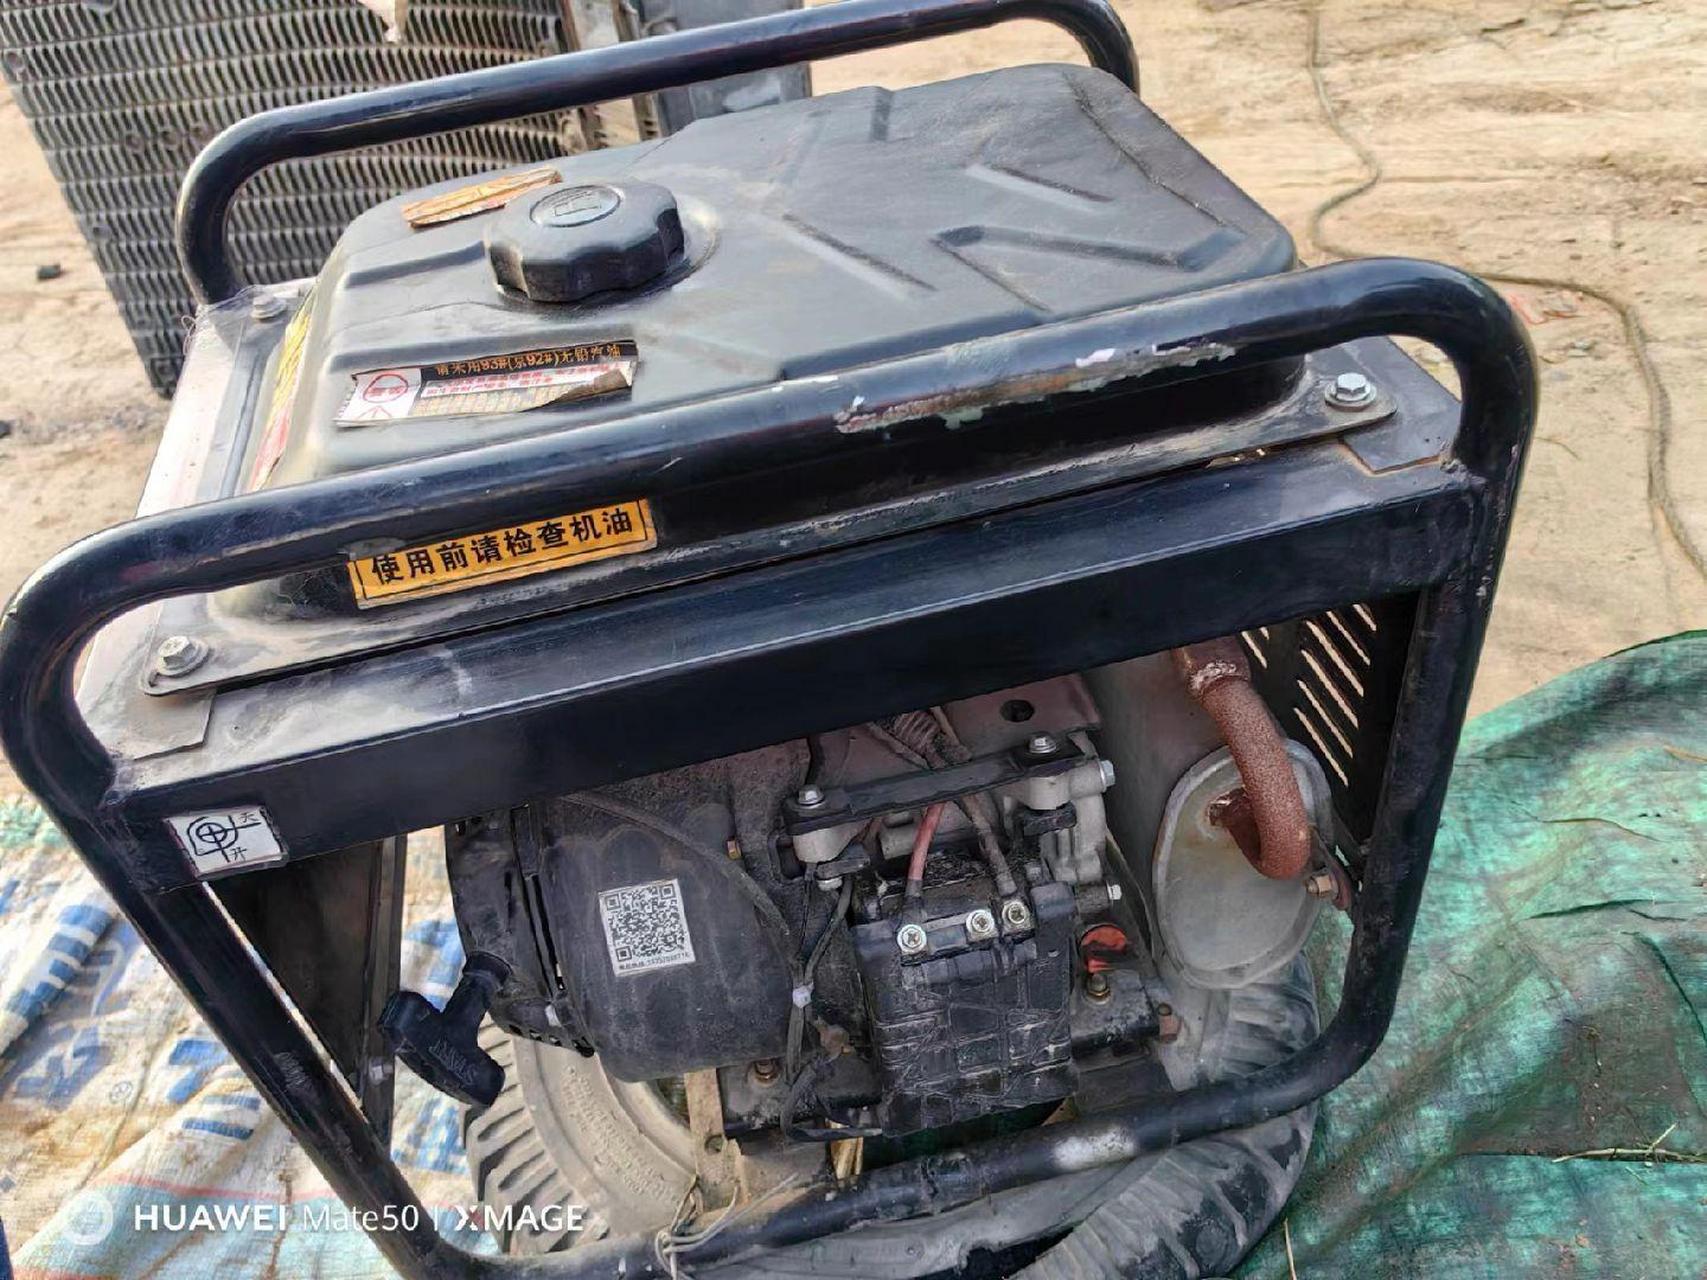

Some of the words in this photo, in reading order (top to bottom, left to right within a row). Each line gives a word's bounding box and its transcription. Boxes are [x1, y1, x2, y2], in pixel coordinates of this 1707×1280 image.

[371, 508, 633, 585] 使用前请检查机油
